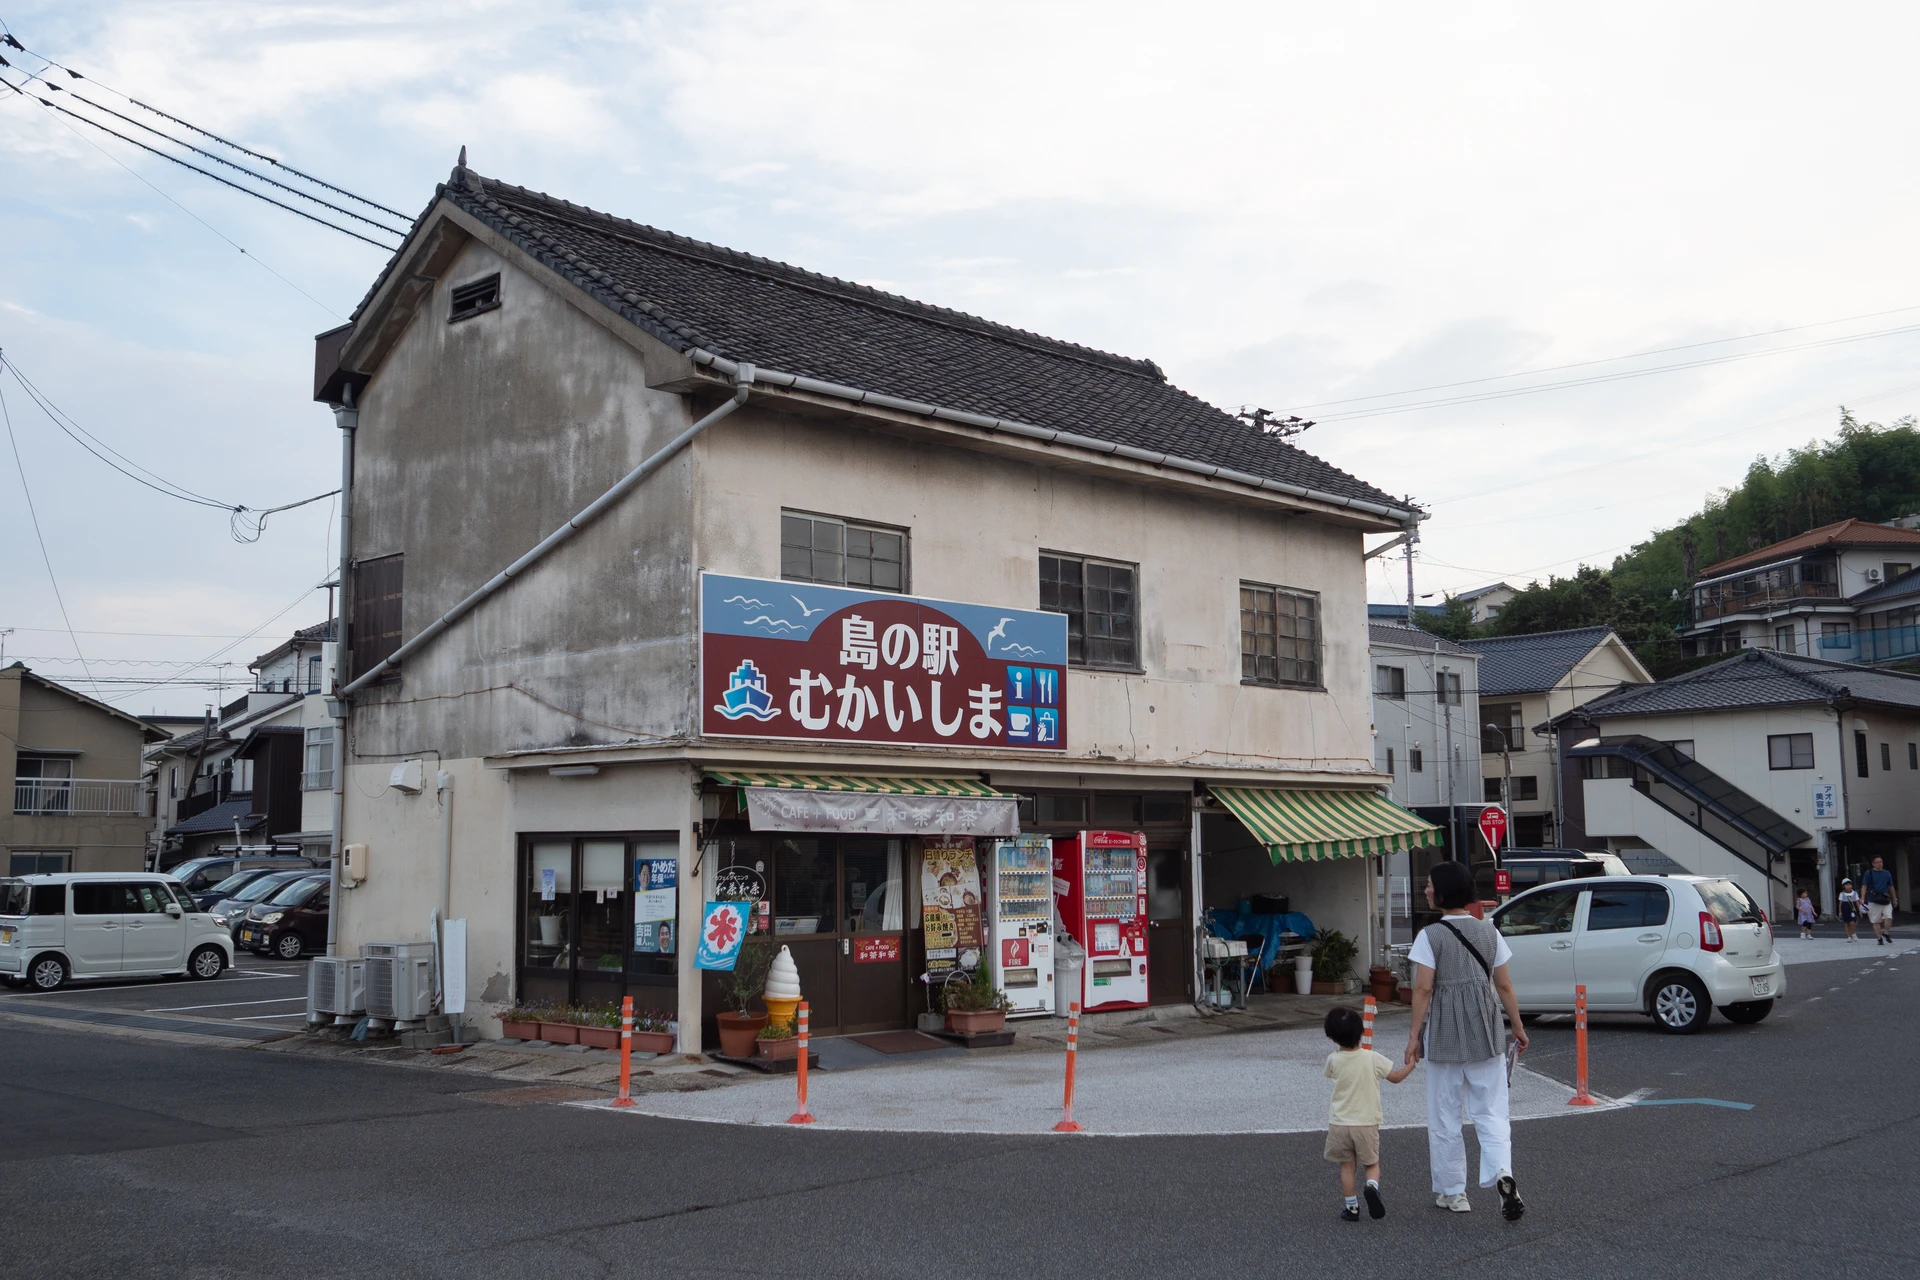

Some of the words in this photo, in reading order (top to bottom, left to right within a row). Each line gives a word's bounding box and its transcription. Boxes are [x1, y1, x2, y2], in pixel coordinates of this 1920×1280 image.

[840, 614, 959, 676] 島の駅
[789, 668, 1003, 739] むかいしま
[1824, 786, 1833, 808] アオキ
[781, 805, 809, 819] CAFE
[826, 807, 857, 821] FOOD
[888, 807, 978, 827] 和茶和茶
[651, 860, 676, 873] かめだ
[636, 924, 652, 937] 吉田
[1008, 958, 1022, 966] FIRE
